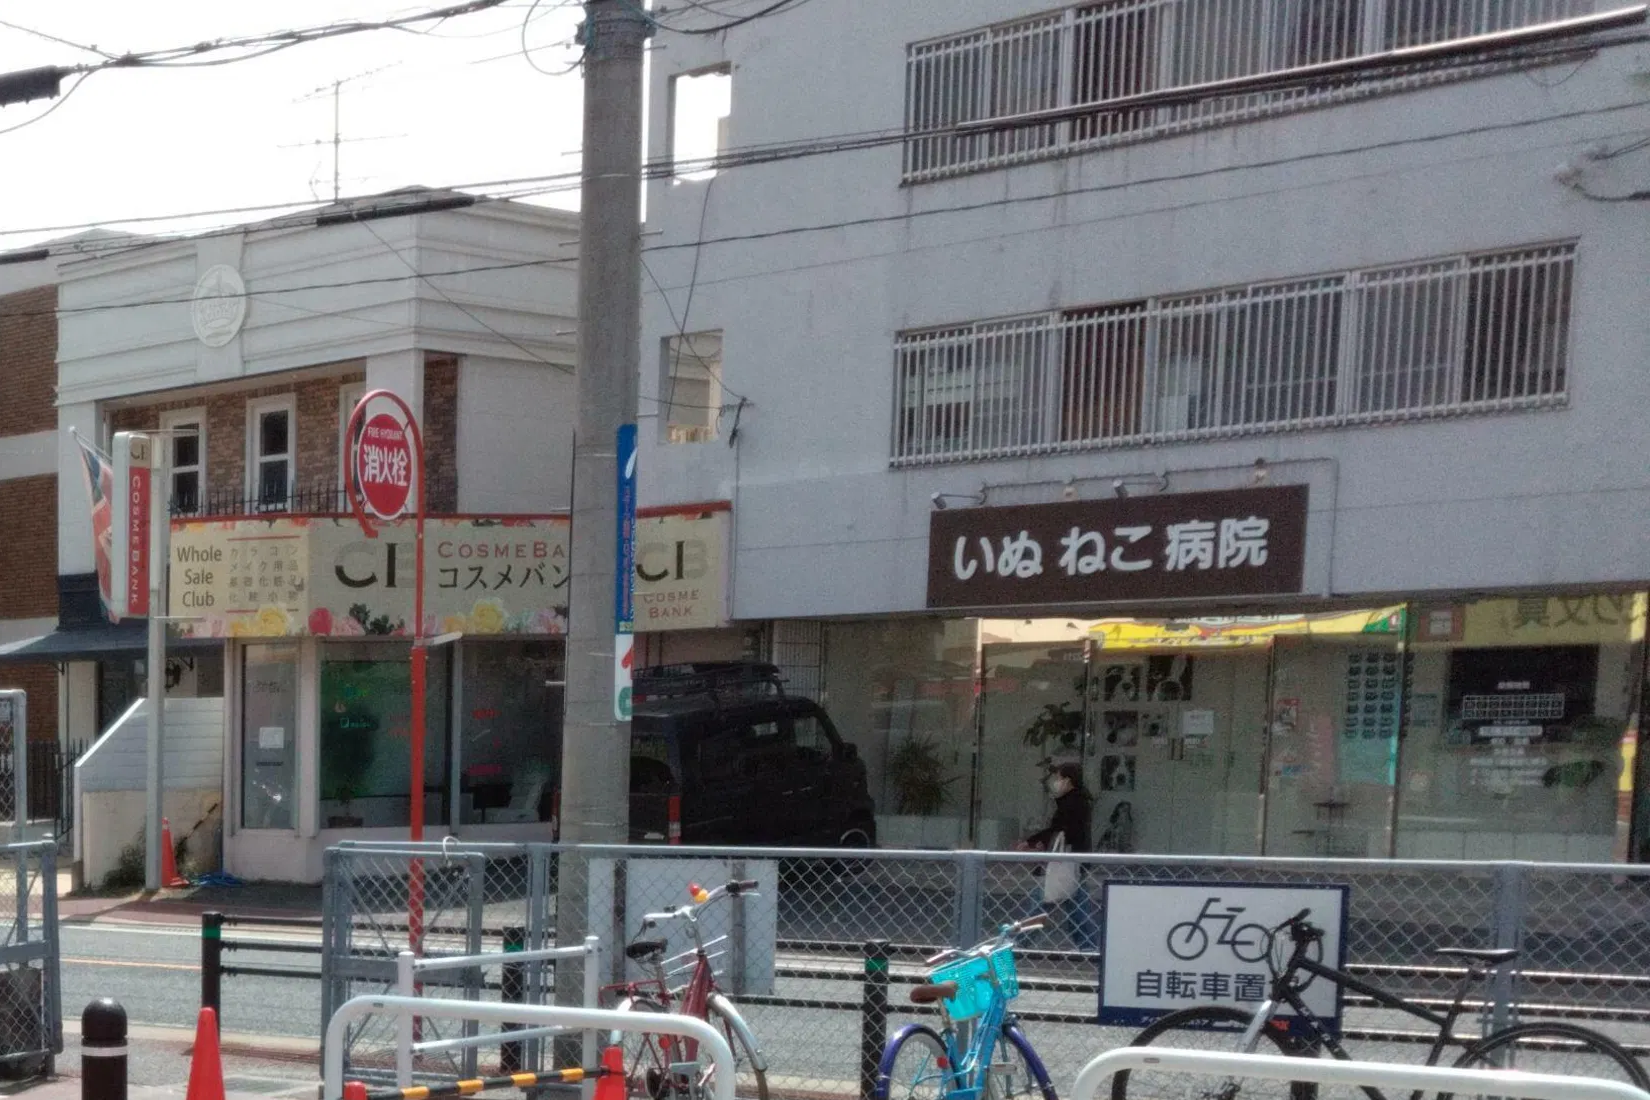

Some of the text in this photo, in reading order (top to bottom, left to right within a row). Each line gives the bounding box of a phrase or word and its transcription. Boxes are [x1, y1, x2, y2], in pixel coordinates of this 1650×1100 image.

[363, 444, 408, 487] 消火栓
[177, 545, 222, 562] Whole
[438, 540, 564, 560] COSMEBA
[184, 568, 214, 585] Sale
[438, 563, 570, 590] コスメバン
[182, 591, 215, 607] Club
[644, 589, 700, 603] COSME
[649, 606, 693, 618] BANK
